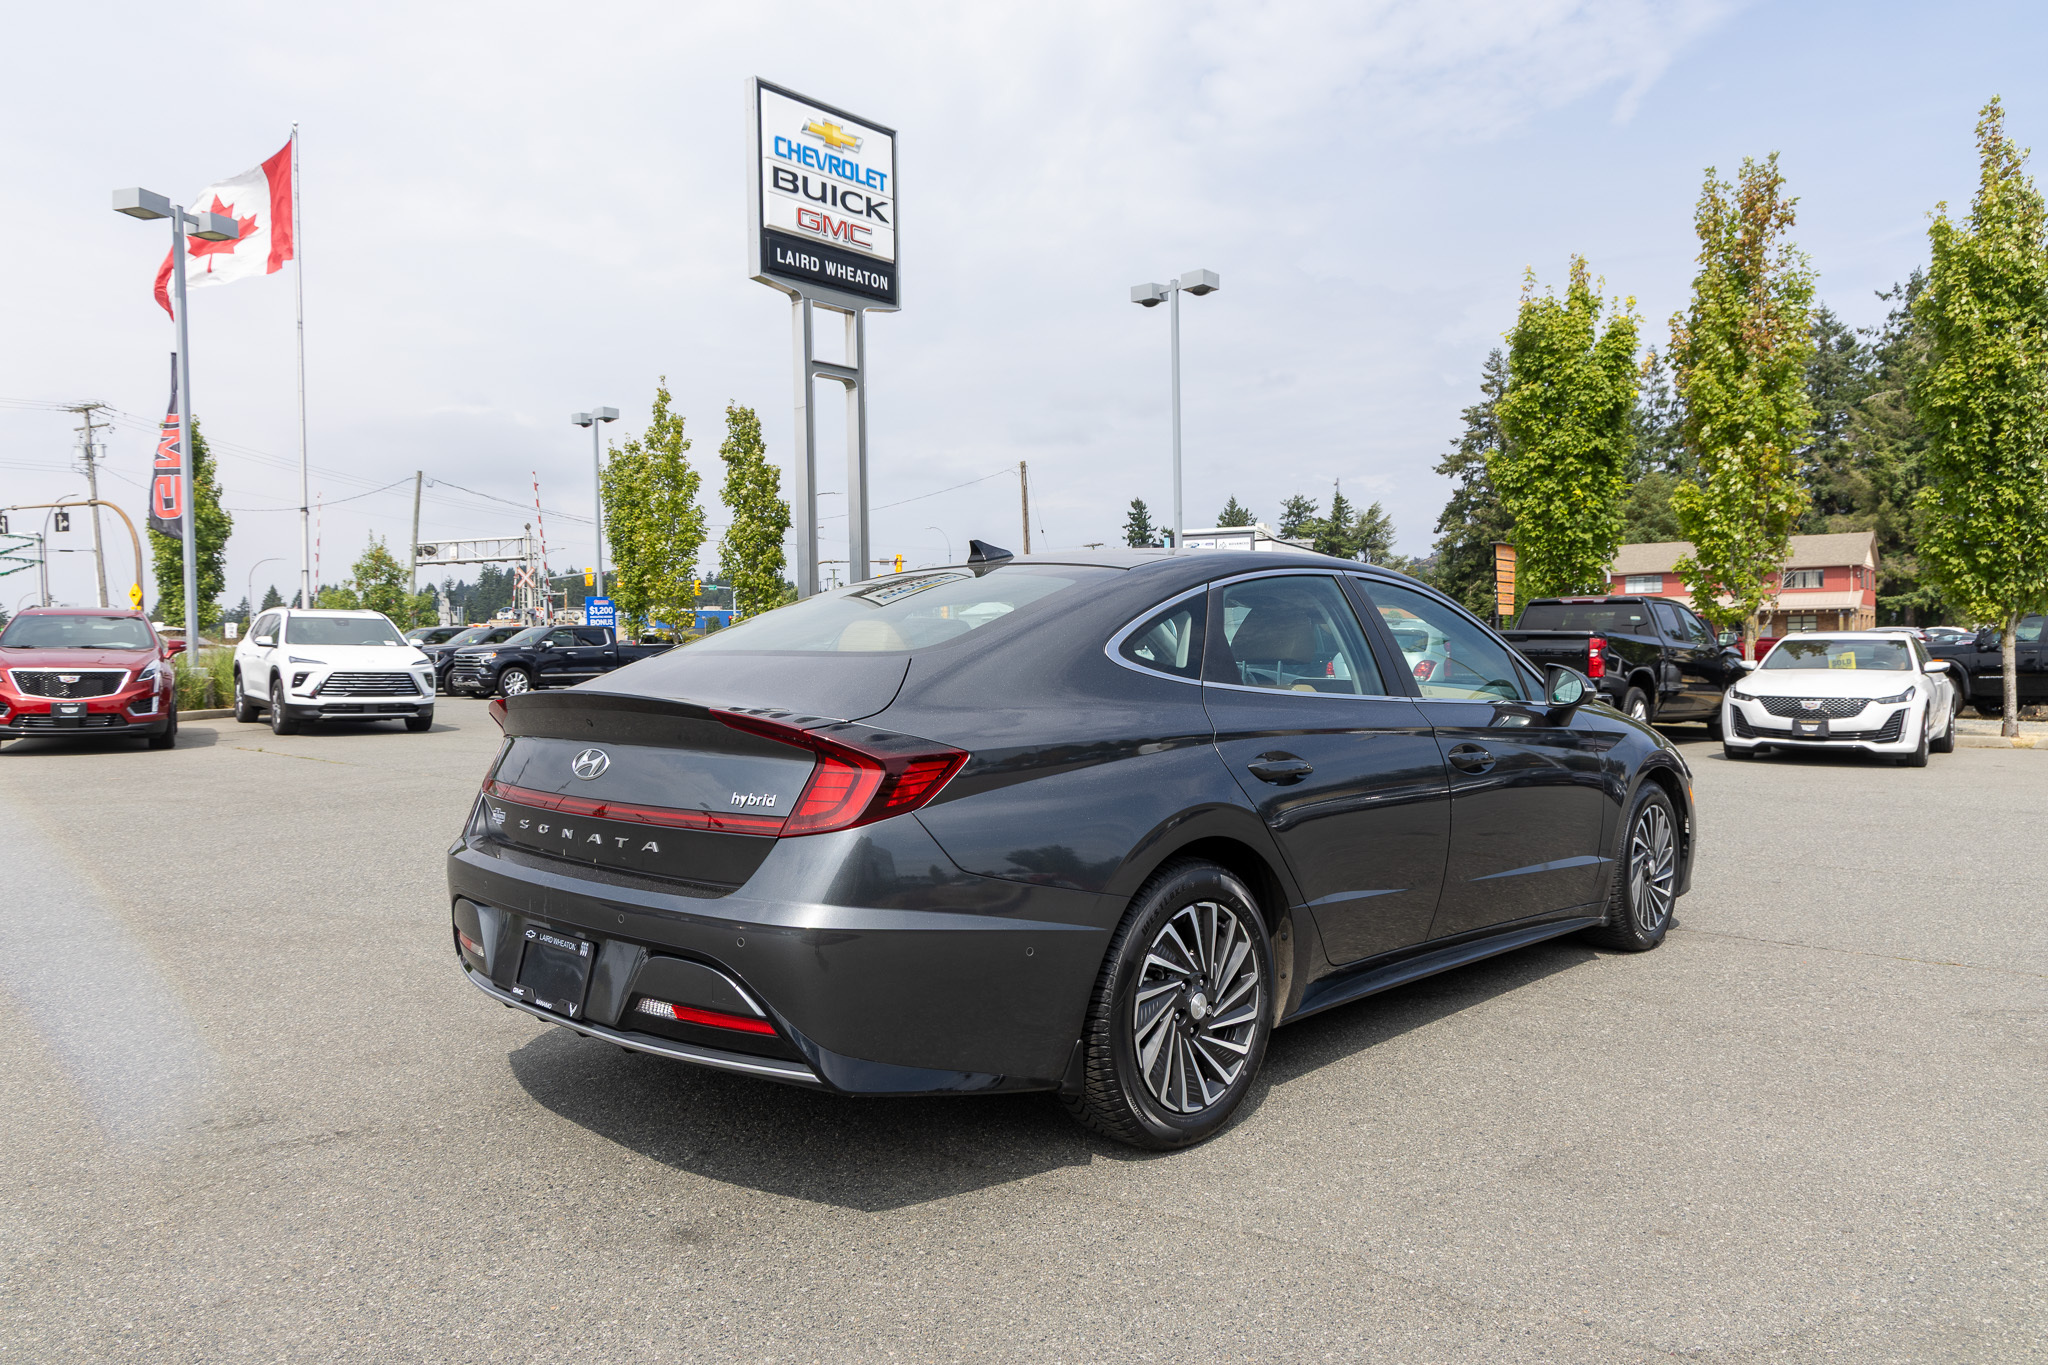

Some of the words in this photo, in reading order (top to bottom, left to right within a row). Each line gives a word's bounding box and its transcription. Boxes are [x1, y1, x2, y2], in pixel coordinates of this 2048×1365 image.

[774, 136, 887, 191] CHEVROLET
[772, 166, 889, 223] BUICK
[796, 207, 872, 249] GMC
[776, 247, 820, 272] LAIRD
[825, 260, 888, 290] WHEATON
[589, 606, 613, 615] $1,200
[1832, 659, 1852, 667] SOLD
[731, 792, 777, 808] hybrid
[519, 819, 660, 853] SONATA
[1141, 884, 1187, 937] WESTLAKE
[539, 933, 553, 944] LAIRD
[553, 937, 576, 951] WHEATON
[512, 987, 524, 996] GMC
